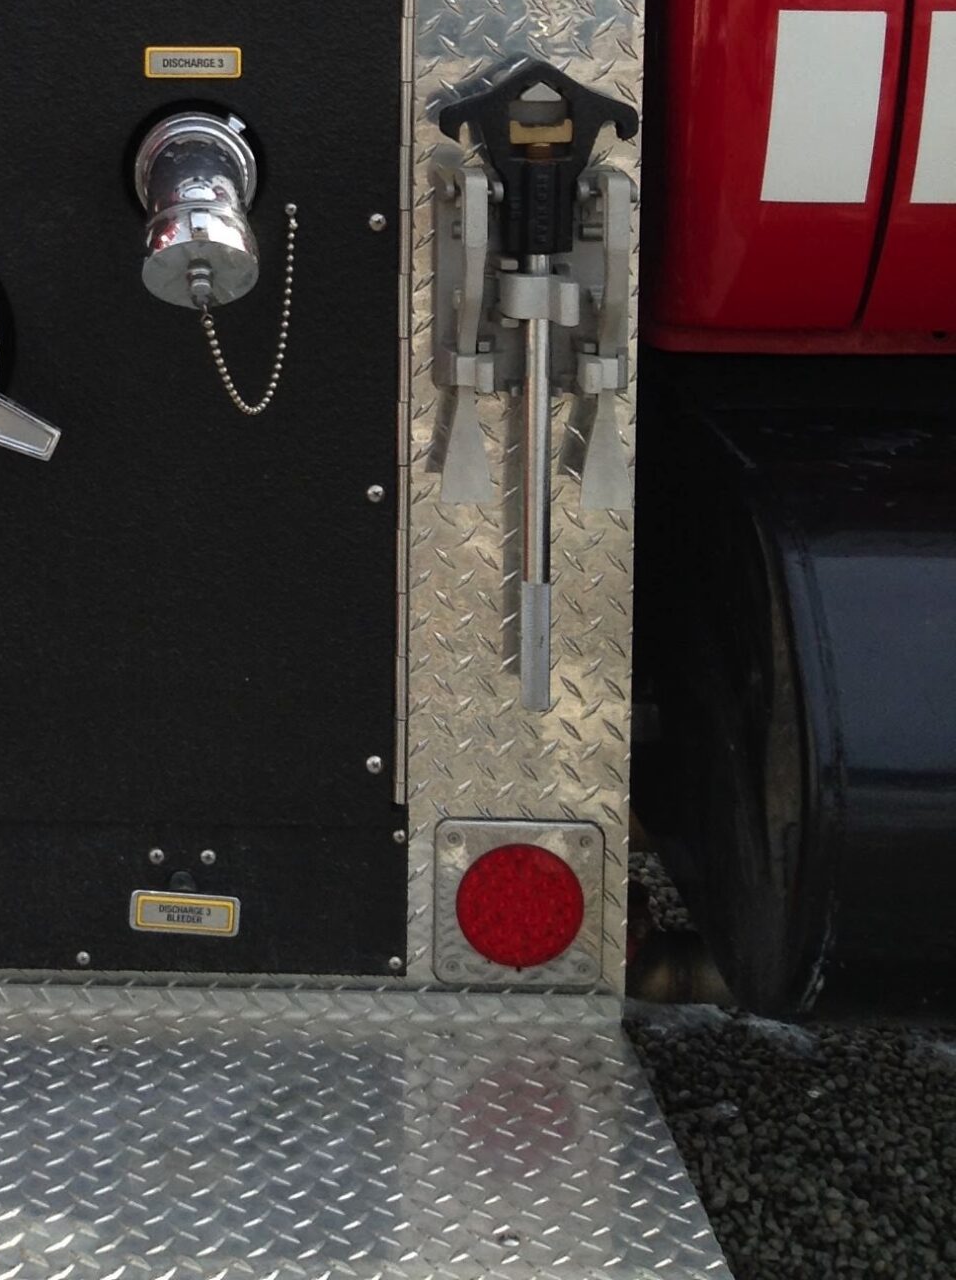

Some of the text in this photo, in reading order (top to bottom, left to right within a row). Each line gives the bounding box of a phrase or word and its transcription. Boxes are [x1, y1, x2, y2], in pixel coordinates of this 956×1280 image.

[162, 58, 224, 68] DISCHARGE 3
[158, 904, 212, 916] DISCHARGE 3
[166, 914, 203, 924] BLEEDER
